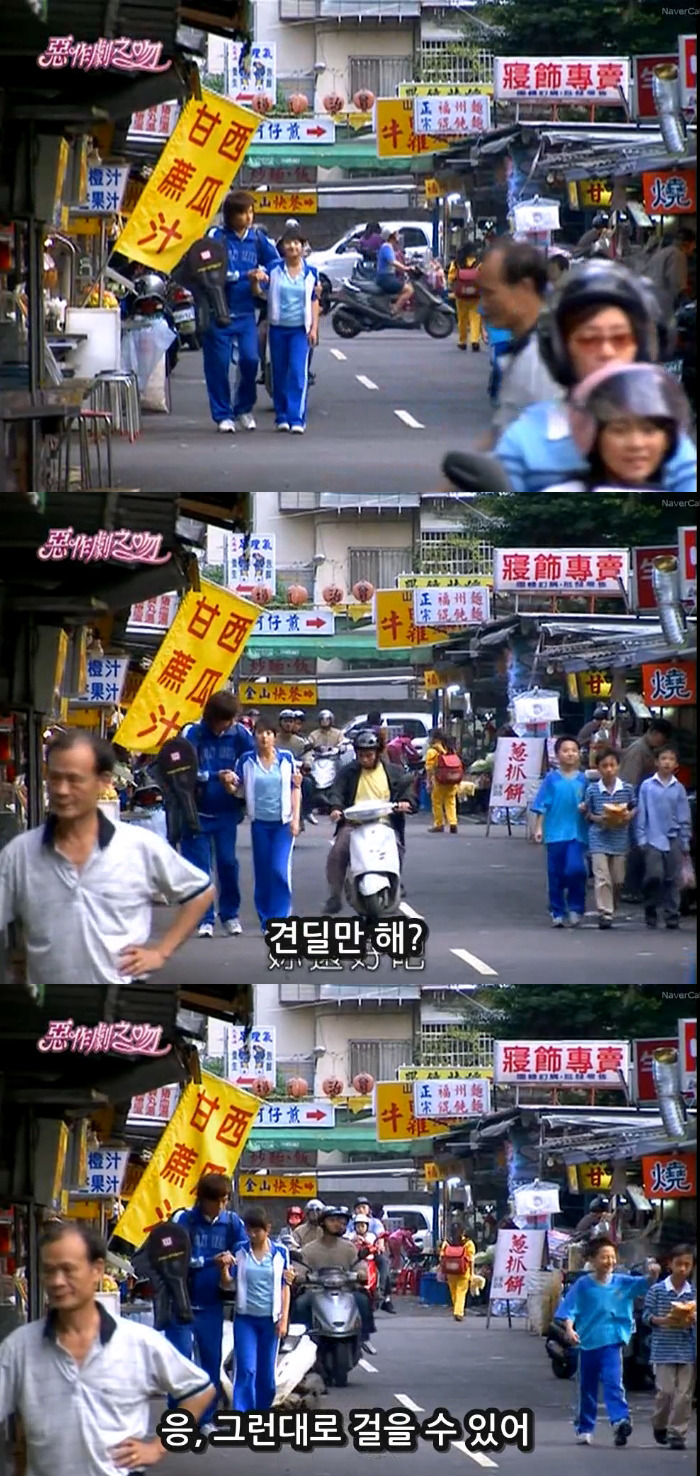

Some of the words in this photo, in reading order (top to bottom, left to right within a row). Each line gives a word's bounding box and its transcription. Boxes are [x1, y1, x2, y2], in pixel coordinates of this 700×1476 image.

[137, 107, 221, 253] 甘蔗汁
[187, 120, 253, 219] 西瓜
[652, 178, 691, 208] 燒
[185, 611, 252, 710] 西瓜
[651, 670, 690, 699] 燒
[652, 1162, 691, 1192] 燒
